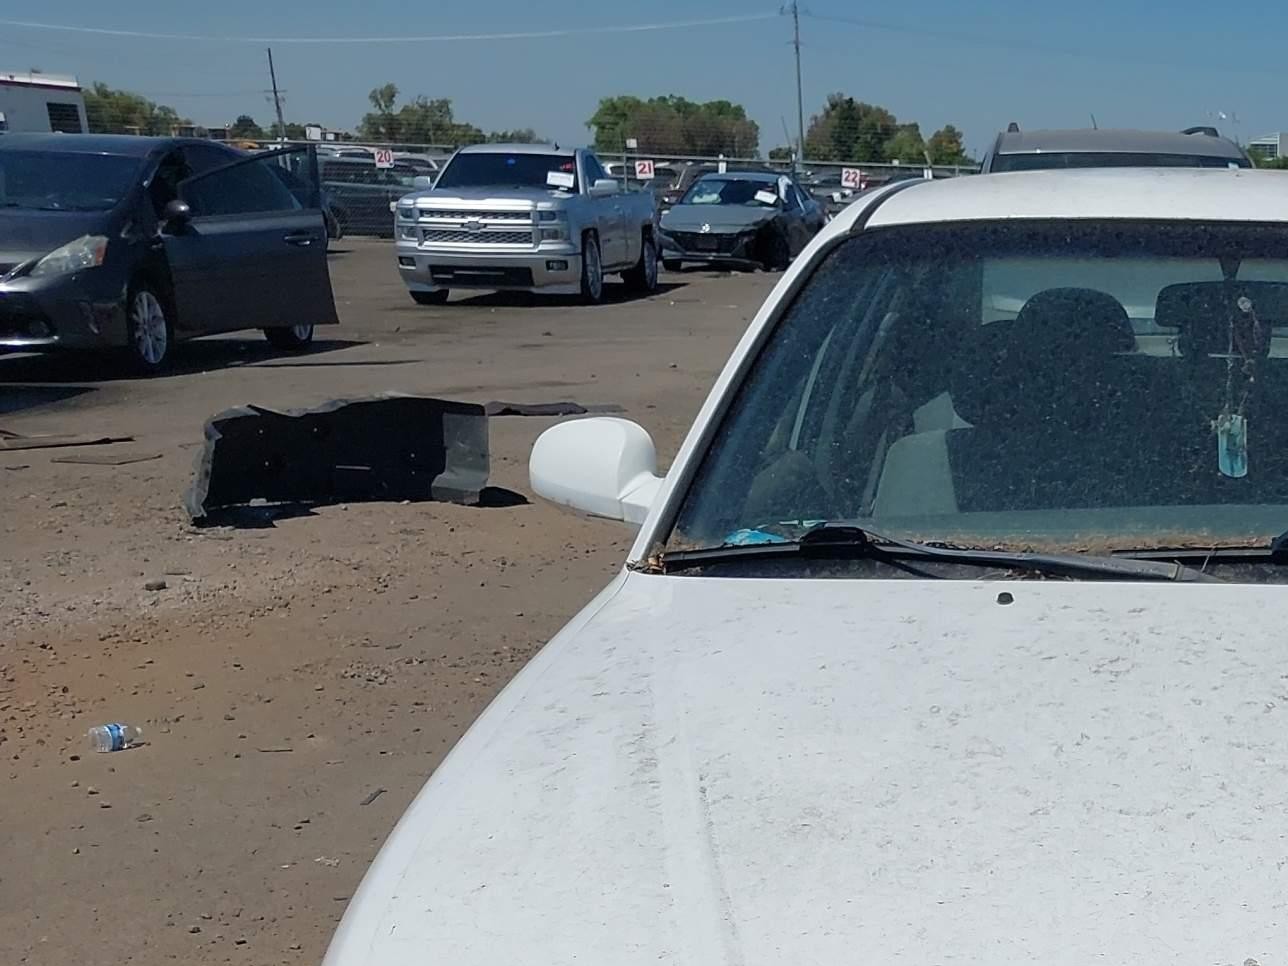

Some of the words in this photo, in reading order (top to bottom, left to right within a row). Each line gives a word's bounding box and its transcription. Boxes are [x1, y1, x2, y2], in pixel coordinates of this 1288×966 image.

[377, 151, 391, 163] 20
[638, 162, 652, 175] 21
[844, 170, 858, 183] 22
